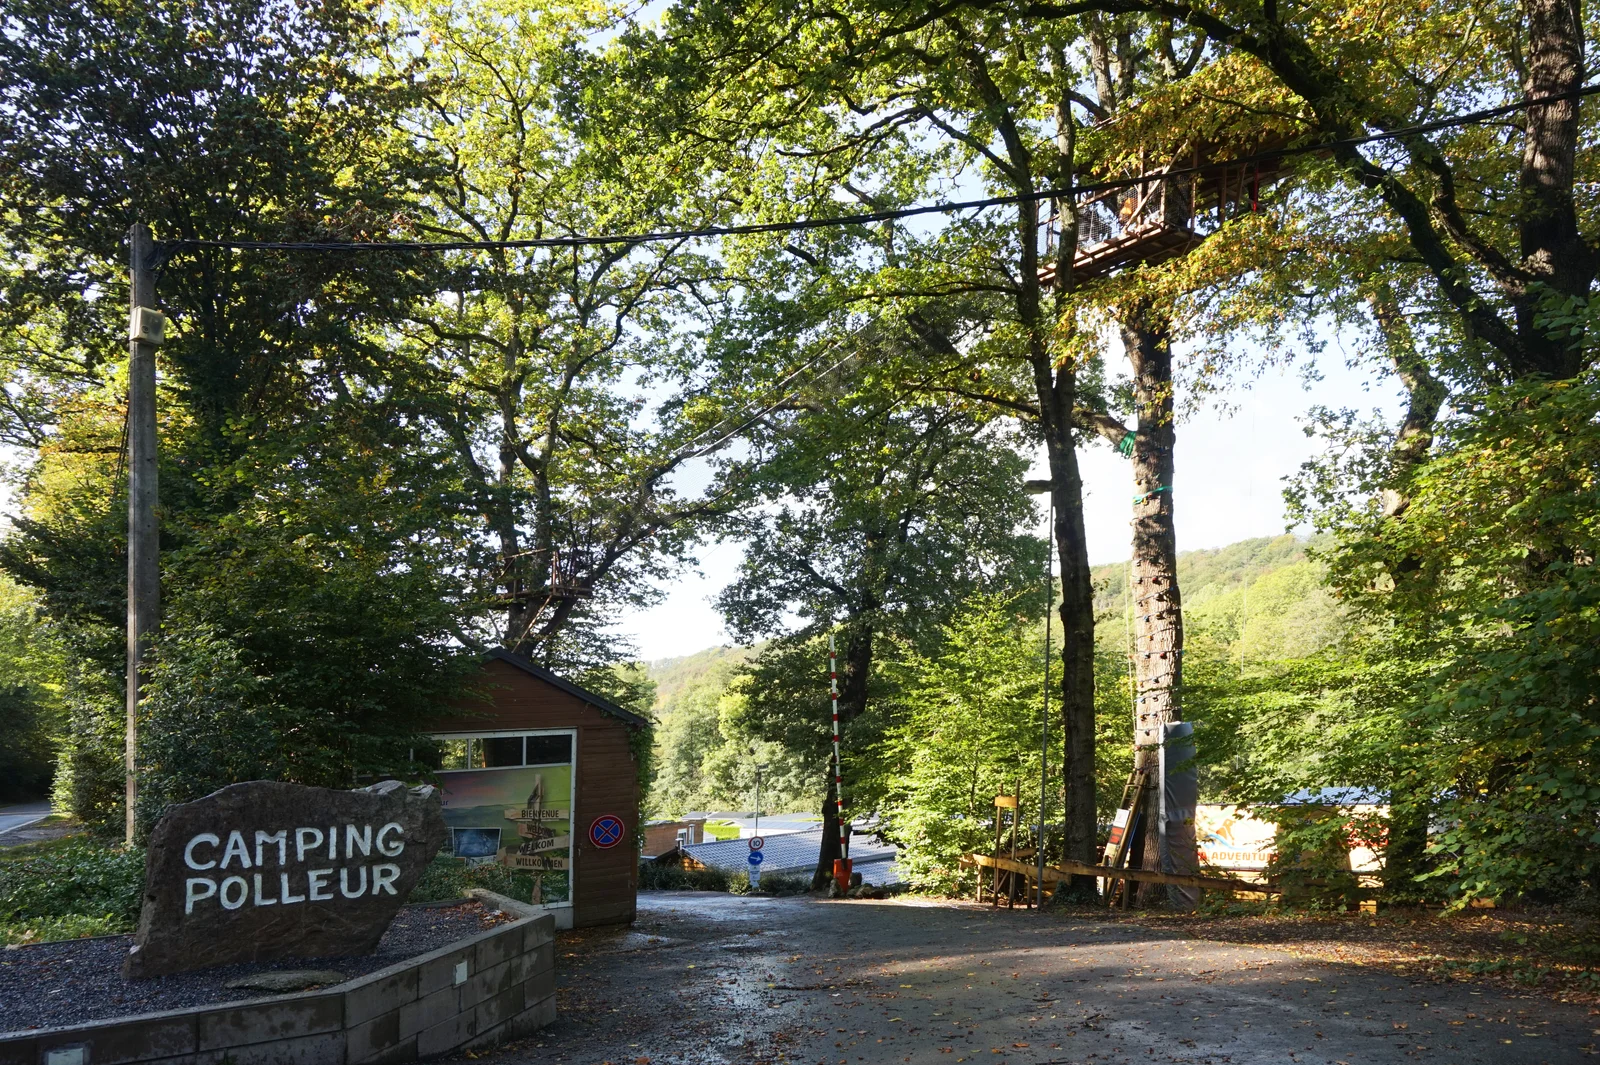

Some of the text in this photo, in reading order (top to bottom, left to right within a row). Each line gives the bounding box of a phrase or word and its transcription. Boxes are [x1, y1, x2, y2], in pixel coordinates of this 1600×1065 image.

[521, 809, 559, 818] BIENVENUE
[184, 822, 405, 870] CAMPING
[519, 839, 554, 853] WELKOM
[1211, 851, 1277, 861] ADVENTU
[516, 857, 563, 868] WILLKOMEN
[184, 863, 401, 915] POLLEUR
